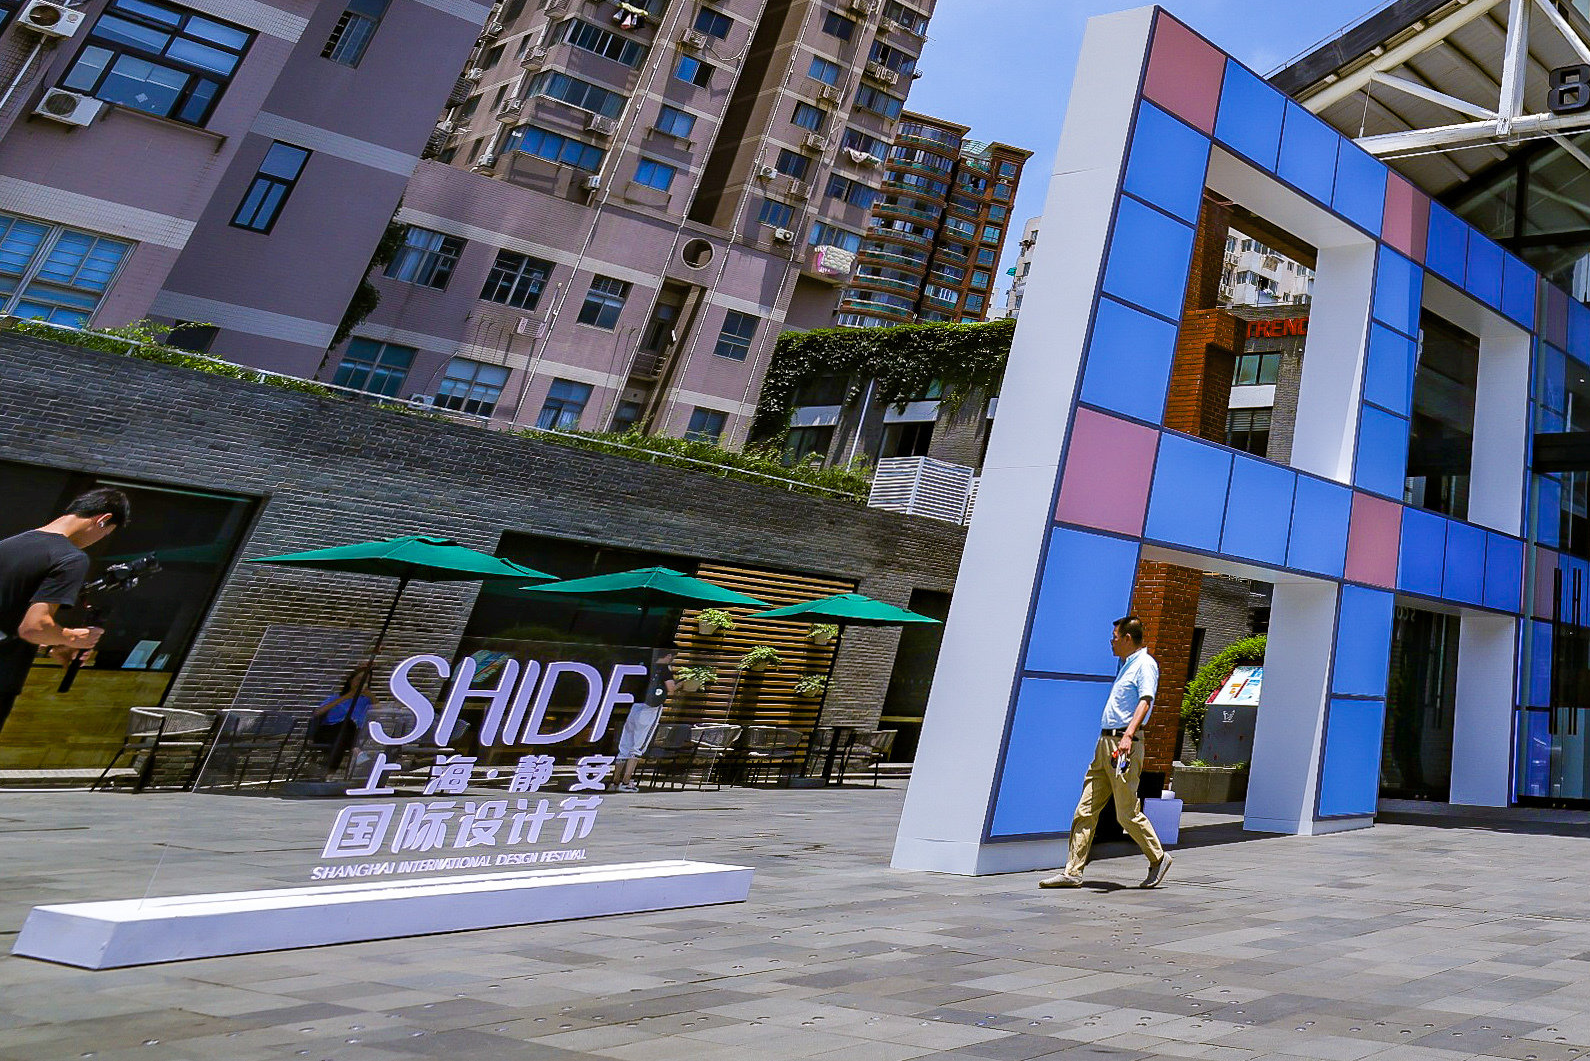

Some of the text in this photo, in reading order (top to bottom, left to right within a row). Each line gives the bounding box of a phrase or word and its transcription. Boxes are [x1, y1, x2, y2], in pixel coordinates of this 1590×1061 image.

[369, 654, 647, 747] SHIDF
[321, 795, 604, 858] 国际设计节
[311, 849, 587, 880] SHANGHAI INTERNATIONAL DESIGN FESTIVAL
